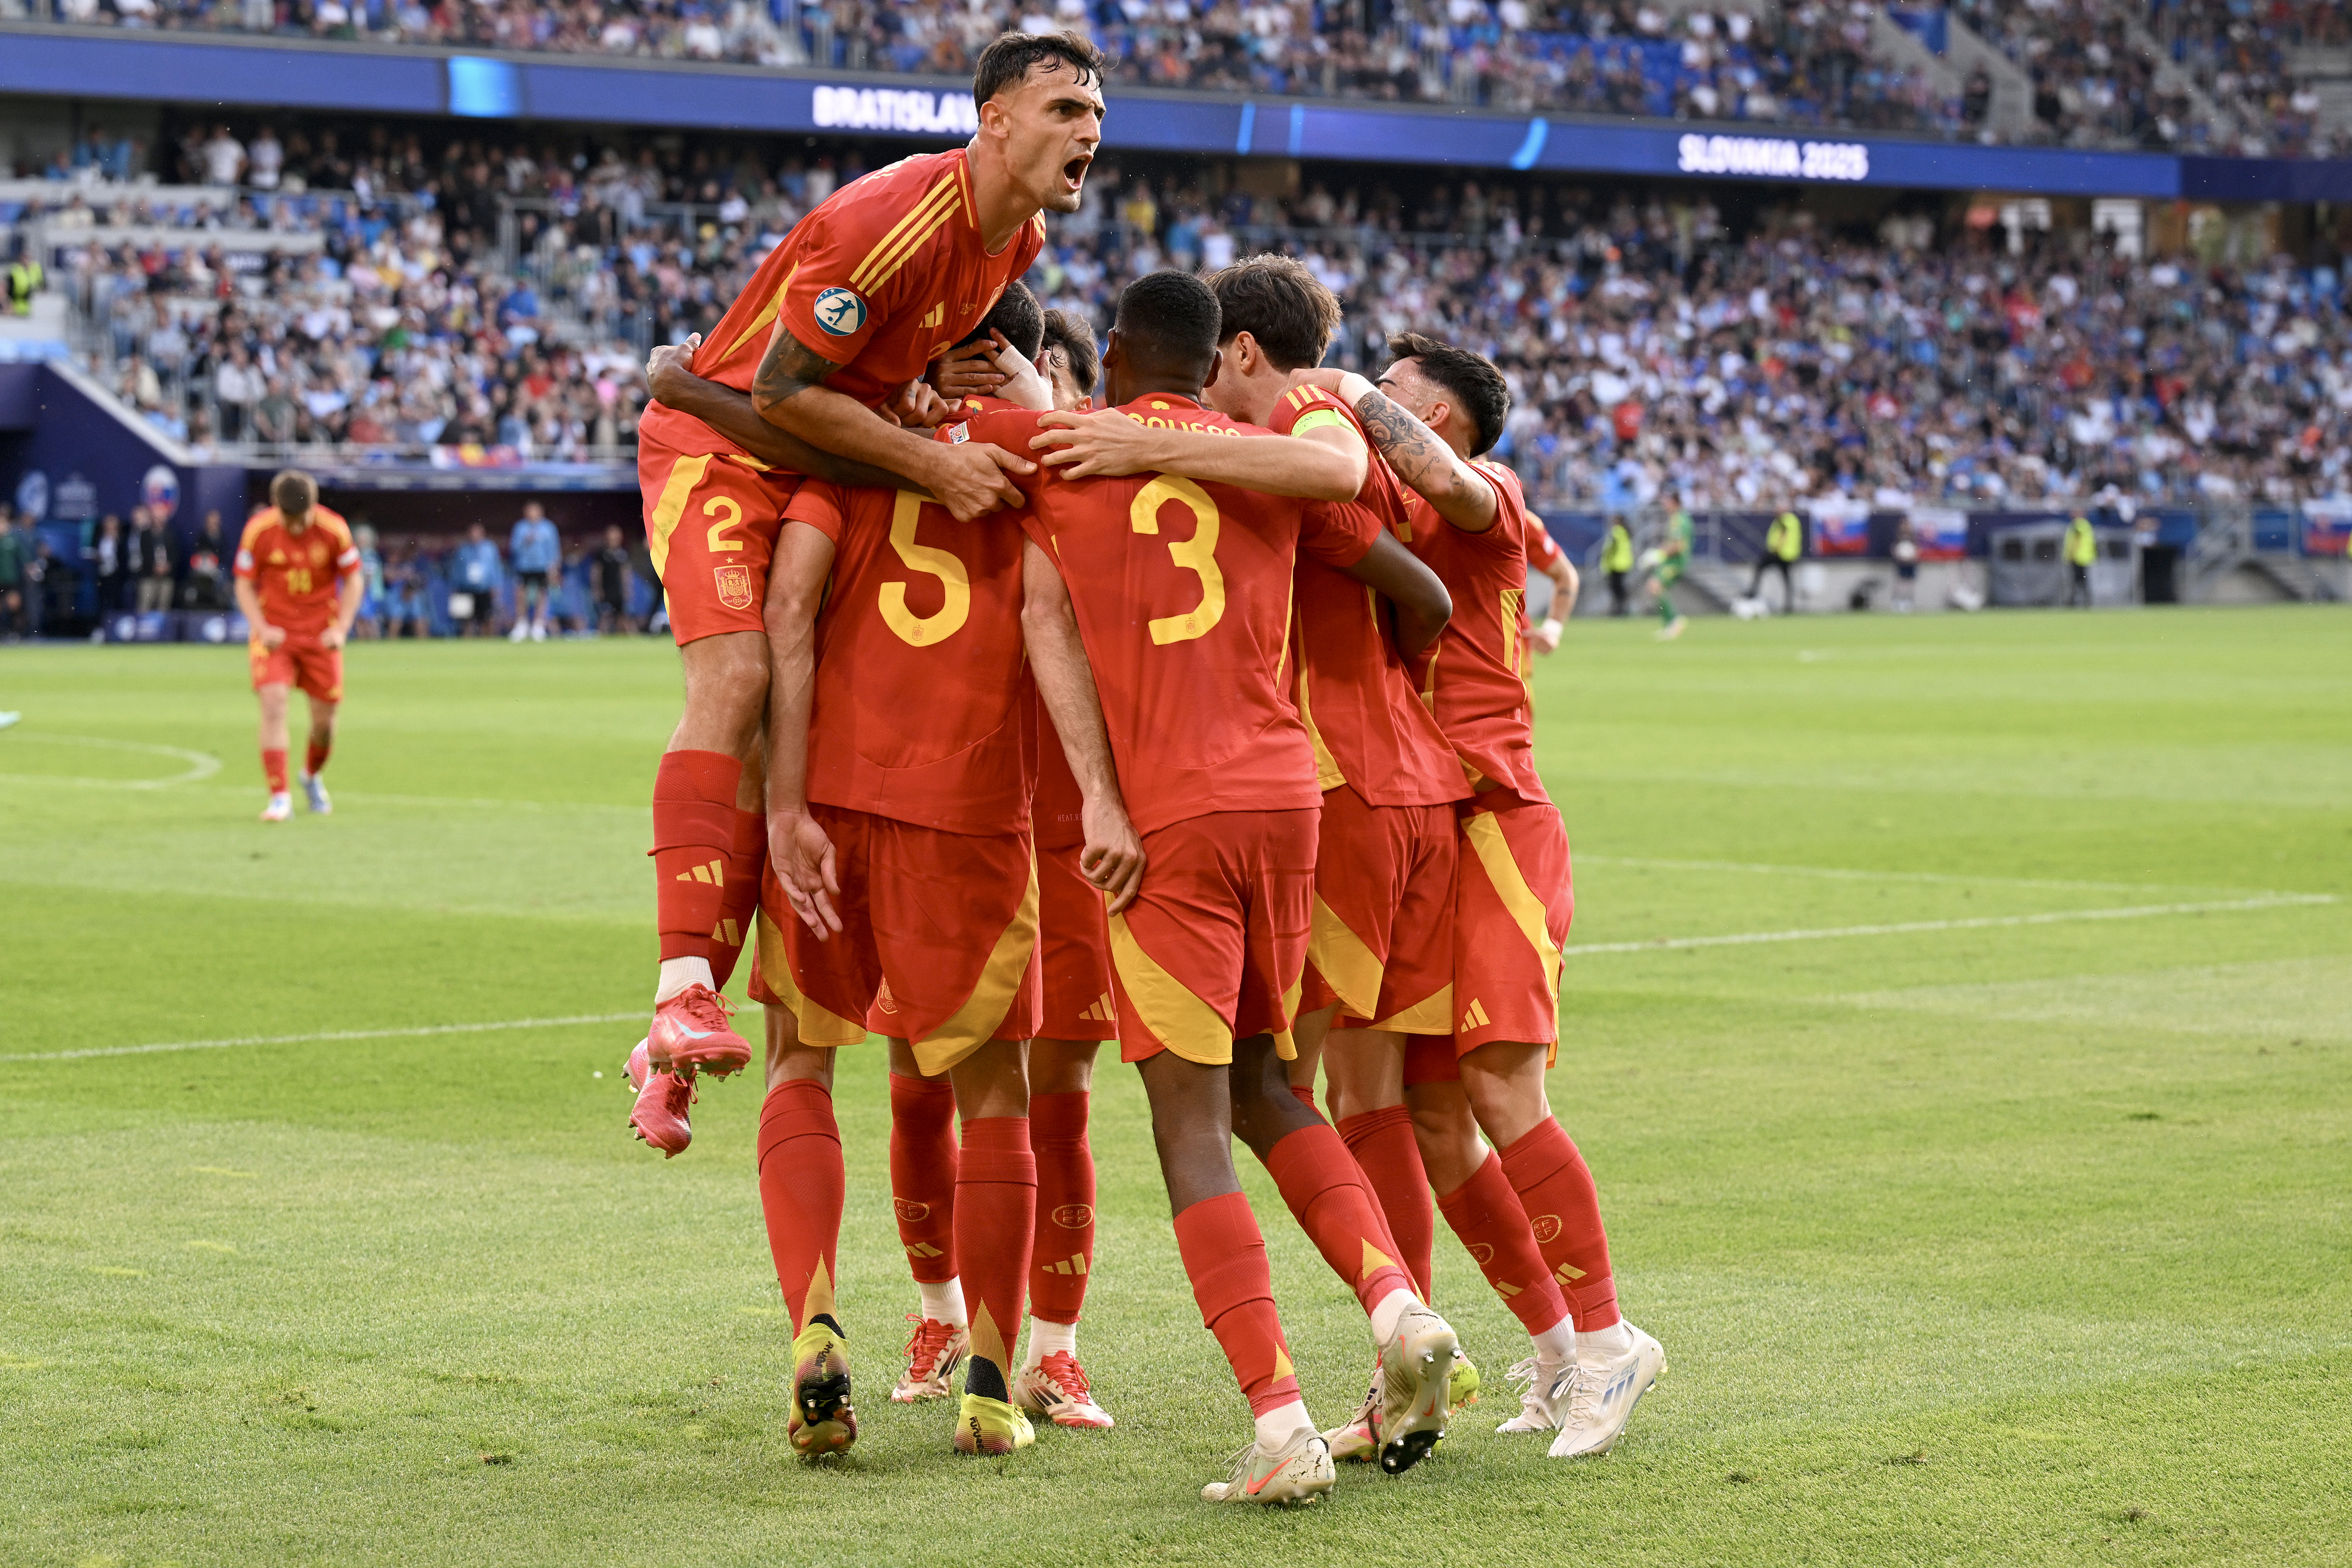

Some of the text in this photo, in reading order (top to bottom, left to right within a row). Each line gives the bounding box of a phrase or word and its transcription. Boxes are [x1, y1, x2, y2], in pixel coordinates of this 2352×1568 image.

[813, 86, 978, 134] BRATISLAV
[1678, 133, 1869, 180] SLOVAKIA 2025
[703, 496, 743, 552] 2
[878, 489, 970, 647] 5
[1130, 475, 1225, 645] 3
[1058, 813, 1082, 822] HEAT.RD
